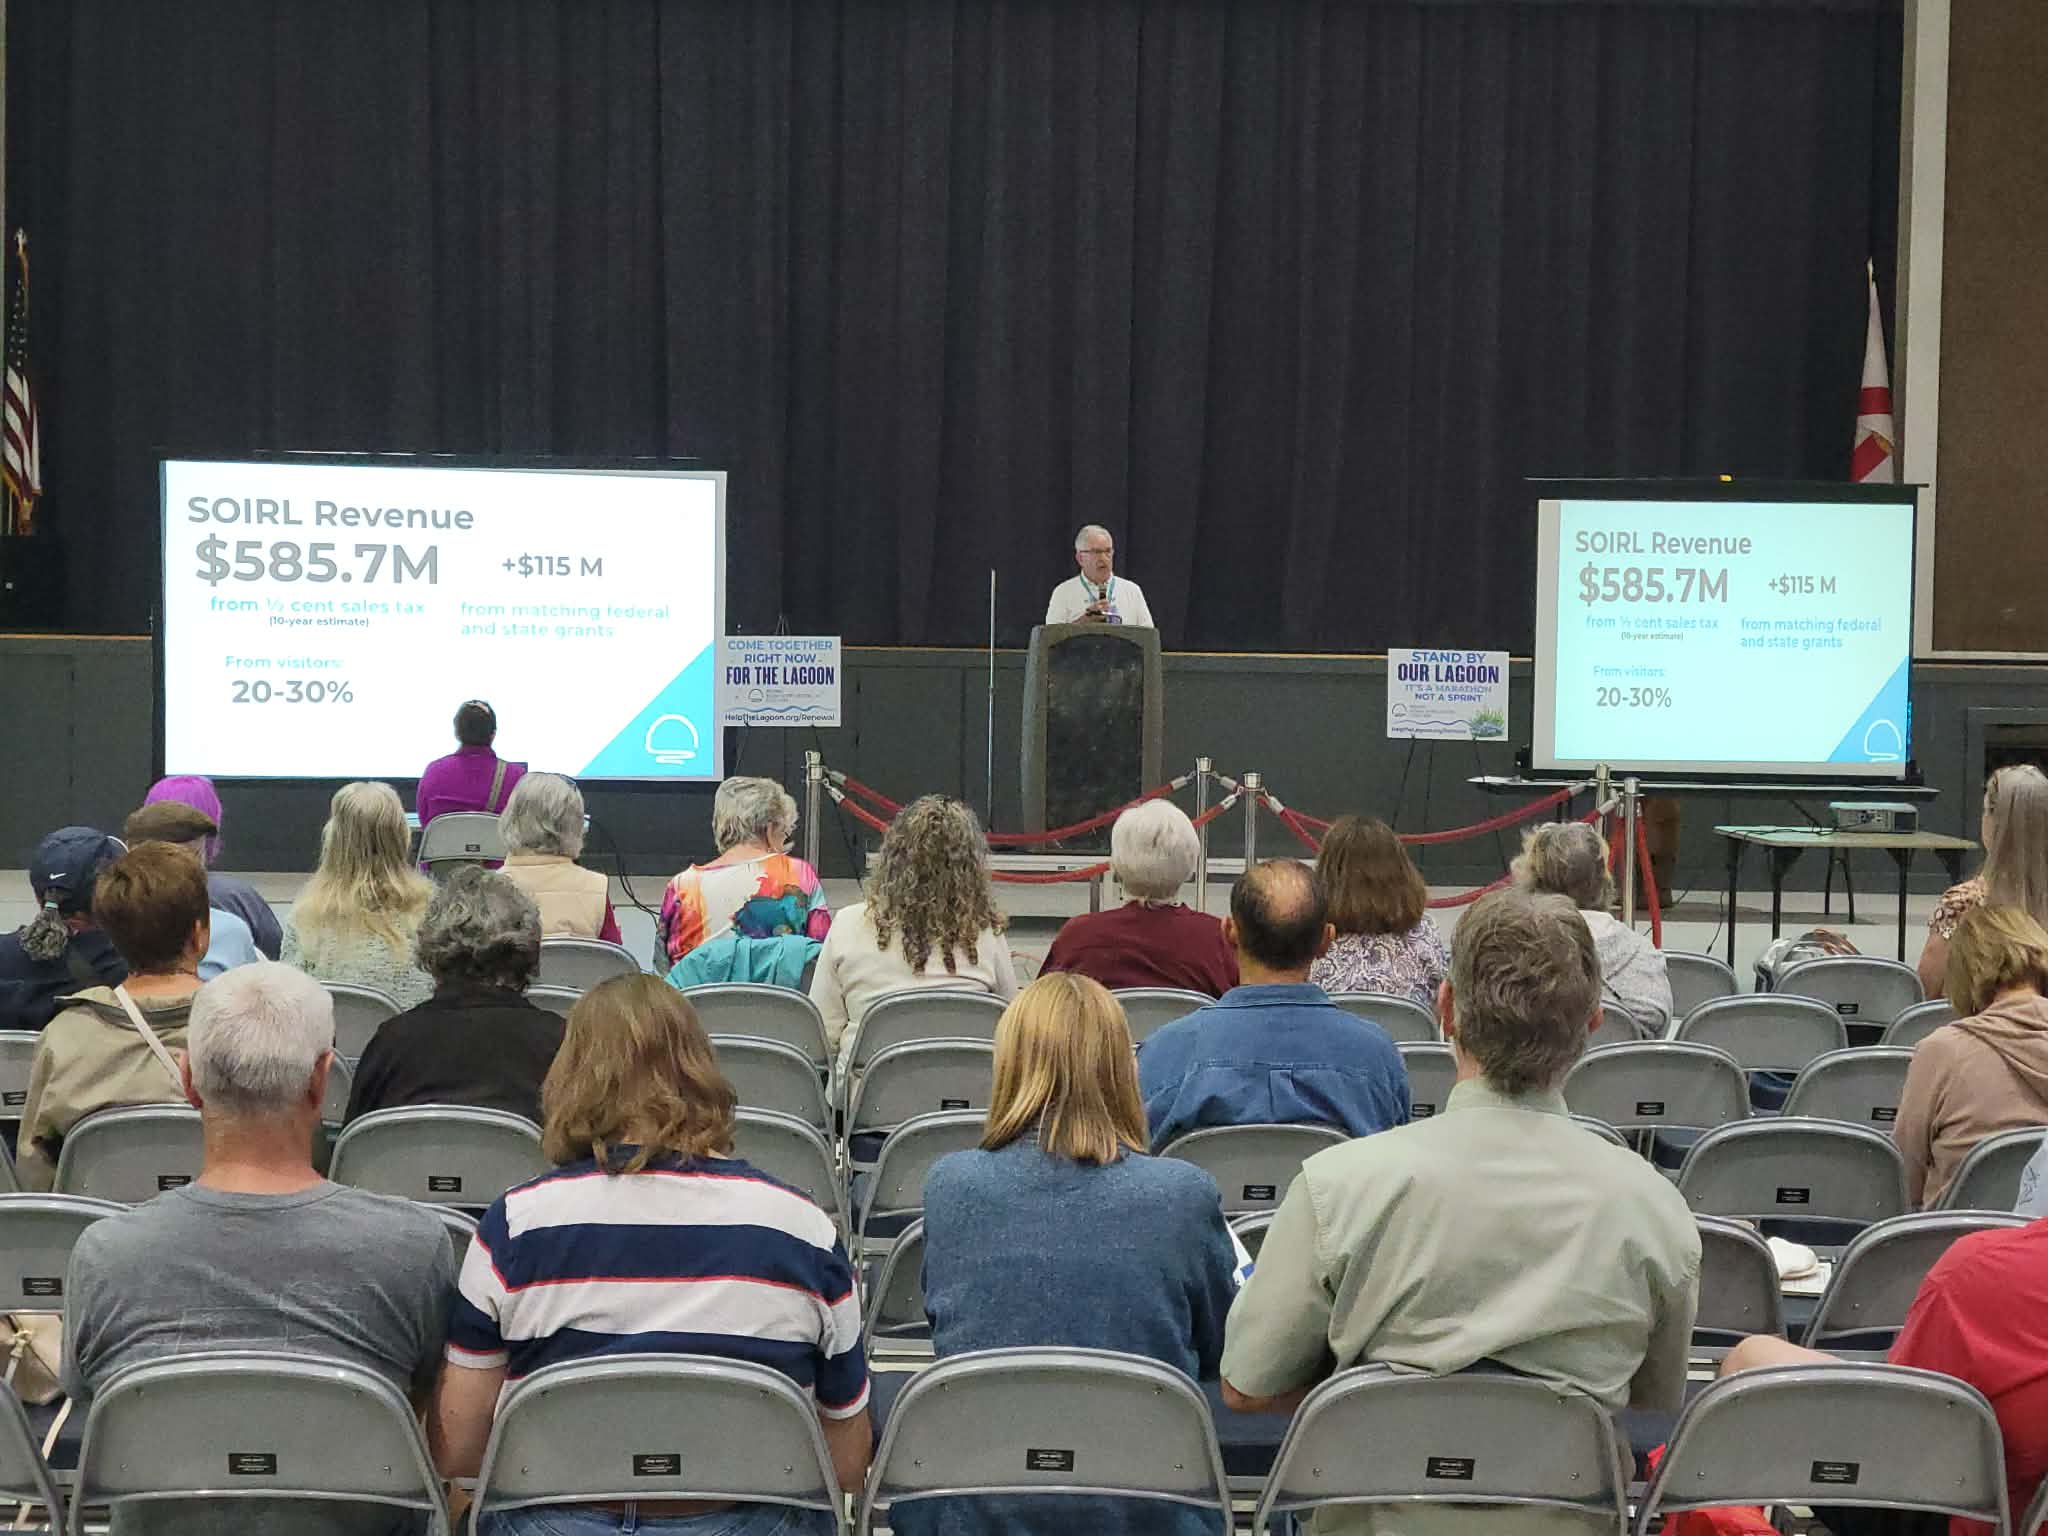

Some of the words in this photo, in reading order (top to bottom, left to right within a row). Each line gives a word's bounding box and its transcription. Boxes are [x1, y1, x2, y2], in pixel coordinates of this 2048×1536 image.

[188, 496, 303, 525] SOIRL
[315, 500, 474, 530] Revenue
[1575, 530, 1645, 554] SOIRL
[1651, 531, 1753, 555] Revenue
[195, 532, 439, 588] $585.7M
[501, 552, 571, 578] +$115
[580, 557, 603, 577] M
[1578, 561, 1728, 608] $585.7M
[1768, 573, 1814, 596] +$115
[1820, 576, 1836, 594] M
[210, 596, 259, 613] from
[290, 600, 333, 614] cent
[340, 600, 389, 615] sales
[396, 601, 425, 615] tax
[460, 602, 505, 617] from
[511, 603, 601, 621] matching
[607, 604, 670, 619] federal
[269, 616, 313, 627] (10-year
[316, 617, 369, 627] estimate)
[460, 622, 496, 636] and
[502, 624, 549, 637] state
[555, 625, 615, 639] grants
[1586, 615, 1616, 629] from
[1634, 617, 1662, 629] cent
[1665, 616, 1697, 630] sales
[1699, 618, 1719, 630] tax
[1741, 617, 1771, 631] from
[1774, 617, 1834, 633] matching
[1837, 617, 1881, 632] federal
[728, 640, 764, 650] COME
[768, 641, 833, 650] TOGETHER
[1741, 635, 1764, 648] and
[1768, 636, 1799, 648] state
[1802, 636, 1843, 650] grants
[225, 655, 271, 669] From
[744, 654, 782, 663] RIGHT
[785, 654, 817, 663] NOW
[1412, 651, 1462, 663] STAND
[1467, 653, 1486, 664] BY
[726, 666, 751, 685] FOR
[754, 666, 779, 685] THE
[783, 666, 835, 685] LAGOON
[1398, 663, 1429, 682] OUR
[1435, 664, 1499, 683] LAGOON
[1593, 666, 1622, 677] From
[231, 680, 354, 704] 20-30%
[1415, 693, 1435, 701] NOT
[1448, 694, 1483, 702] SPRINT
[1596, 687, 1672, 708] 20-30%
